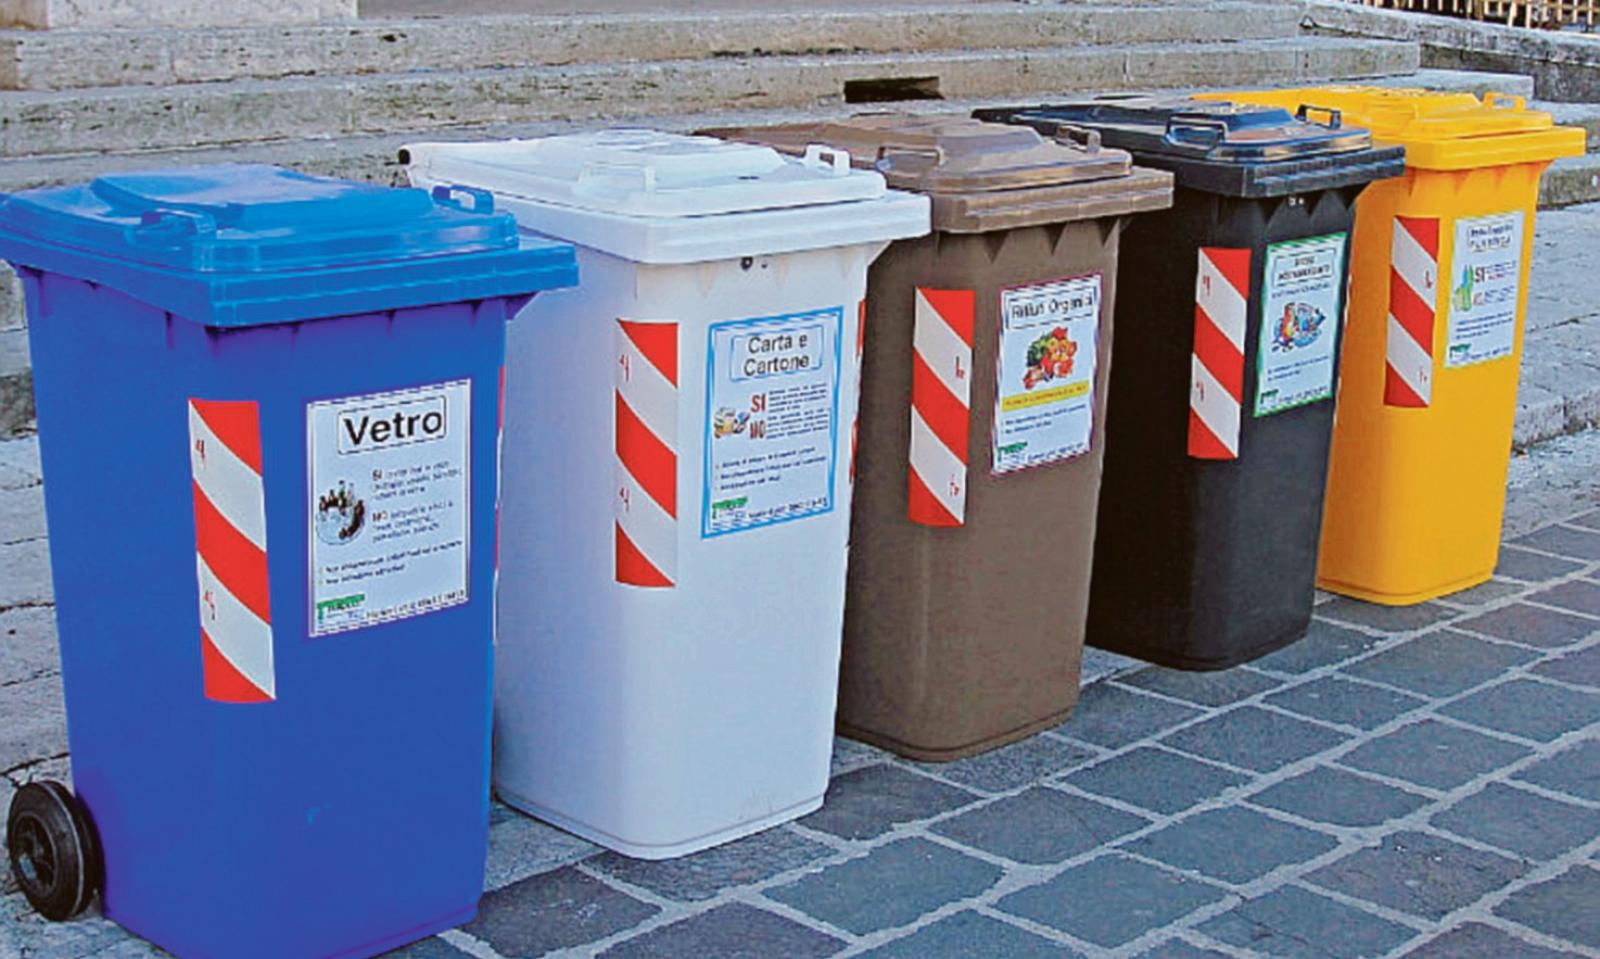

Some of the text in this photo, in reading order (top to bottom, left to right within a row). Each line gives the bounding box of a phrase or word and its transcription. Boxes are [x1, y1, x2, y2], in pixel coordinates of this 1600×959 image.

[748, 334, 808, 354] Carta e
[743, 355, 810, 376] Cartone
[751, 393, 766, 413] SI
[343, 411, 442, 446] Vetro
